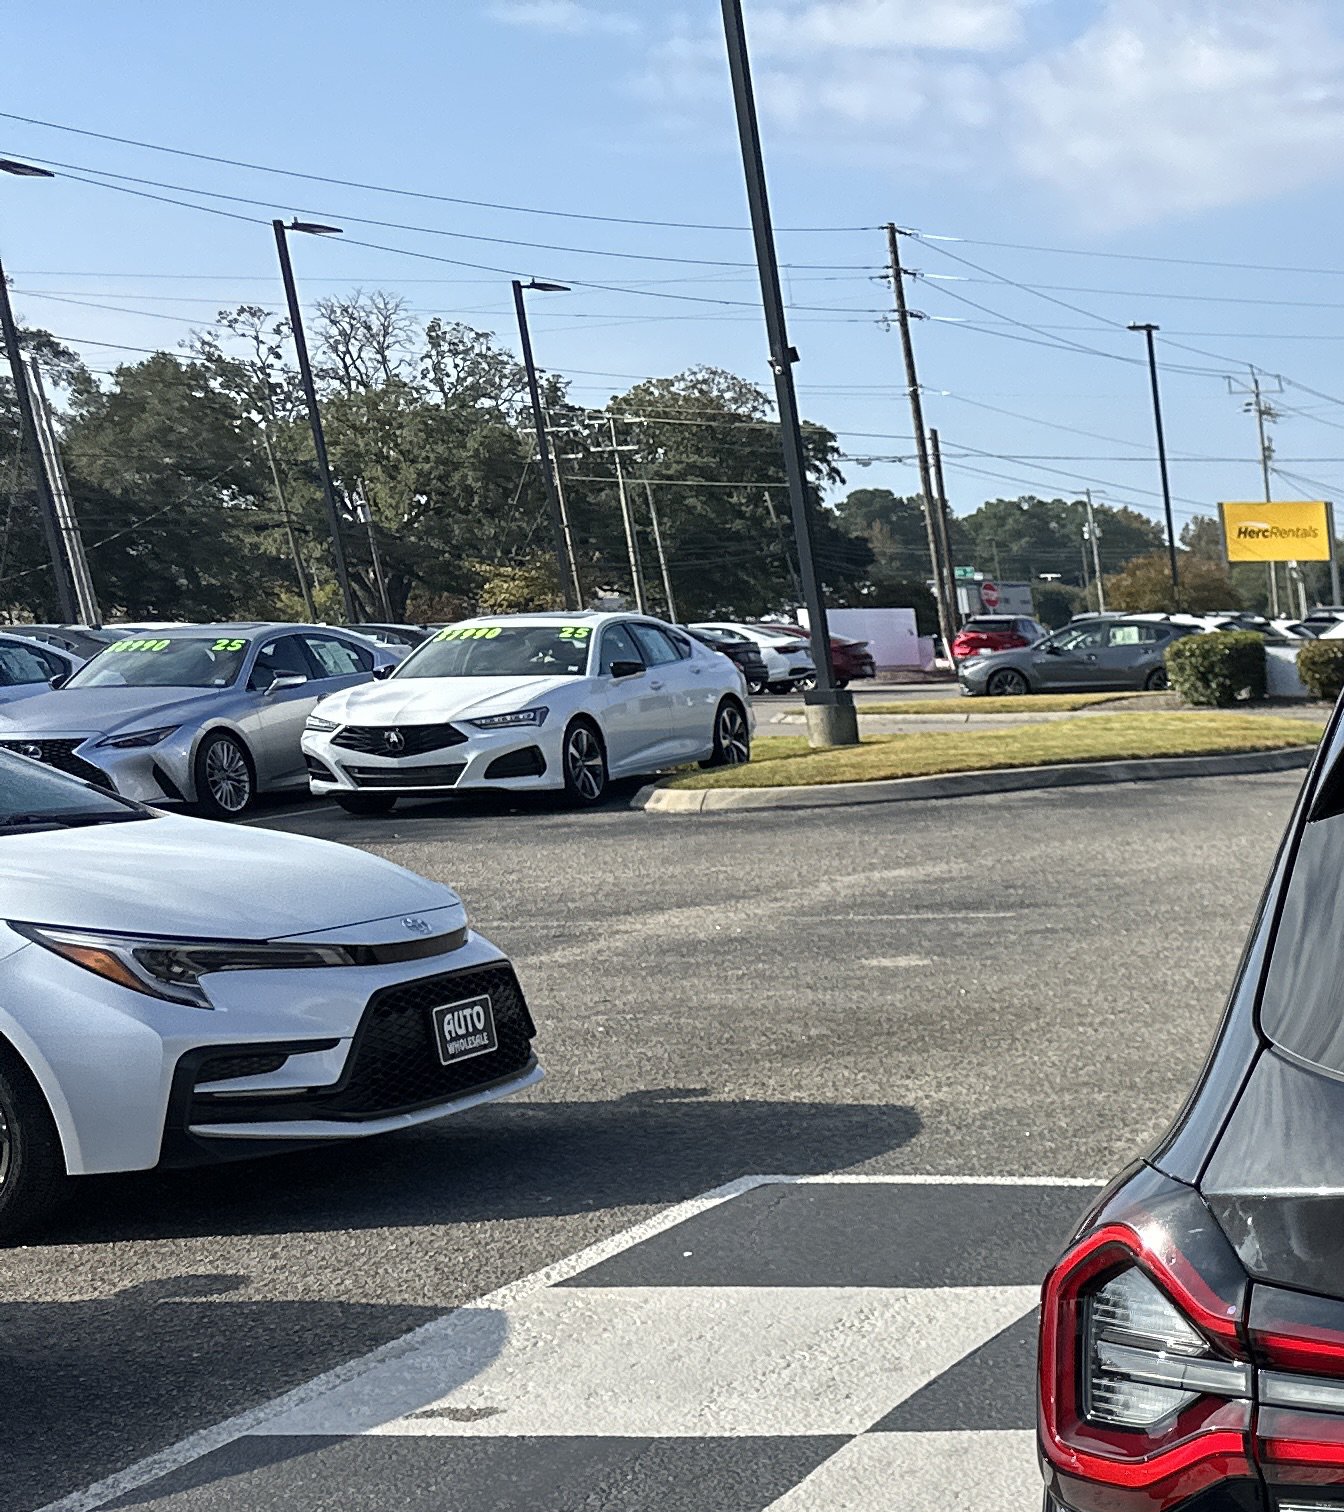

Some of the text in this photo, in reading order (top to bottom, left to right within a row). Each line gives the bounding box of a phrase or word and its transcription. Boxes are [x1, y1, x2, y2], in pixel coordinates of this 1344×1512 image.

[558, 627, 590, 638] 25
[211, 639, 246, 651] 25
[443, 1005, 485, 1040] AUTO
[446, 1032, 489, 1054] WHOLESALE
